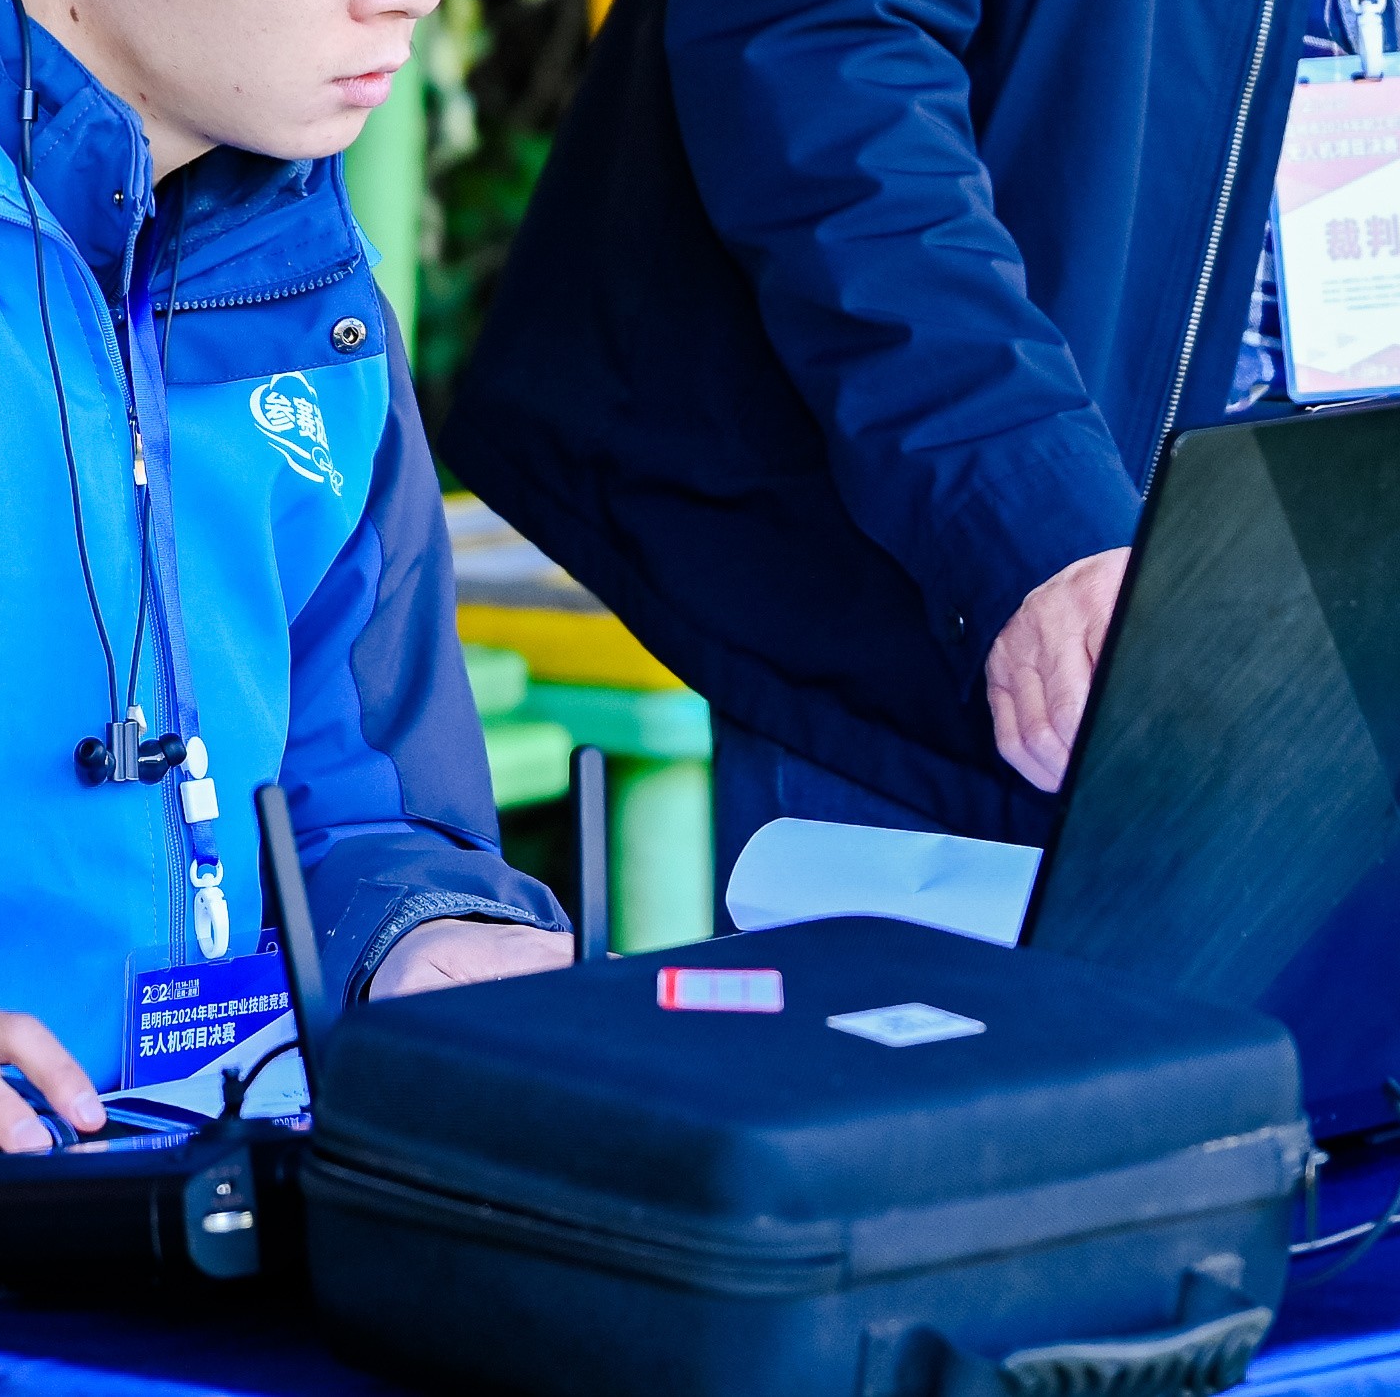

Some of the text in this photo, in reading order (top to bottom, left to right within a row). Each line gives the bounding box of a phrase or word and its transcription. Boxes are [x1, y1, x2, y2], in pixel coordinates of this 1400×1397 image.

[142, 980, 174, 1004] 2024
[141, 992, 290, 1030] 昆明市2024年职工职业技能竞赛
[140, 1021, 236, 1057] 无人机项目决赛
